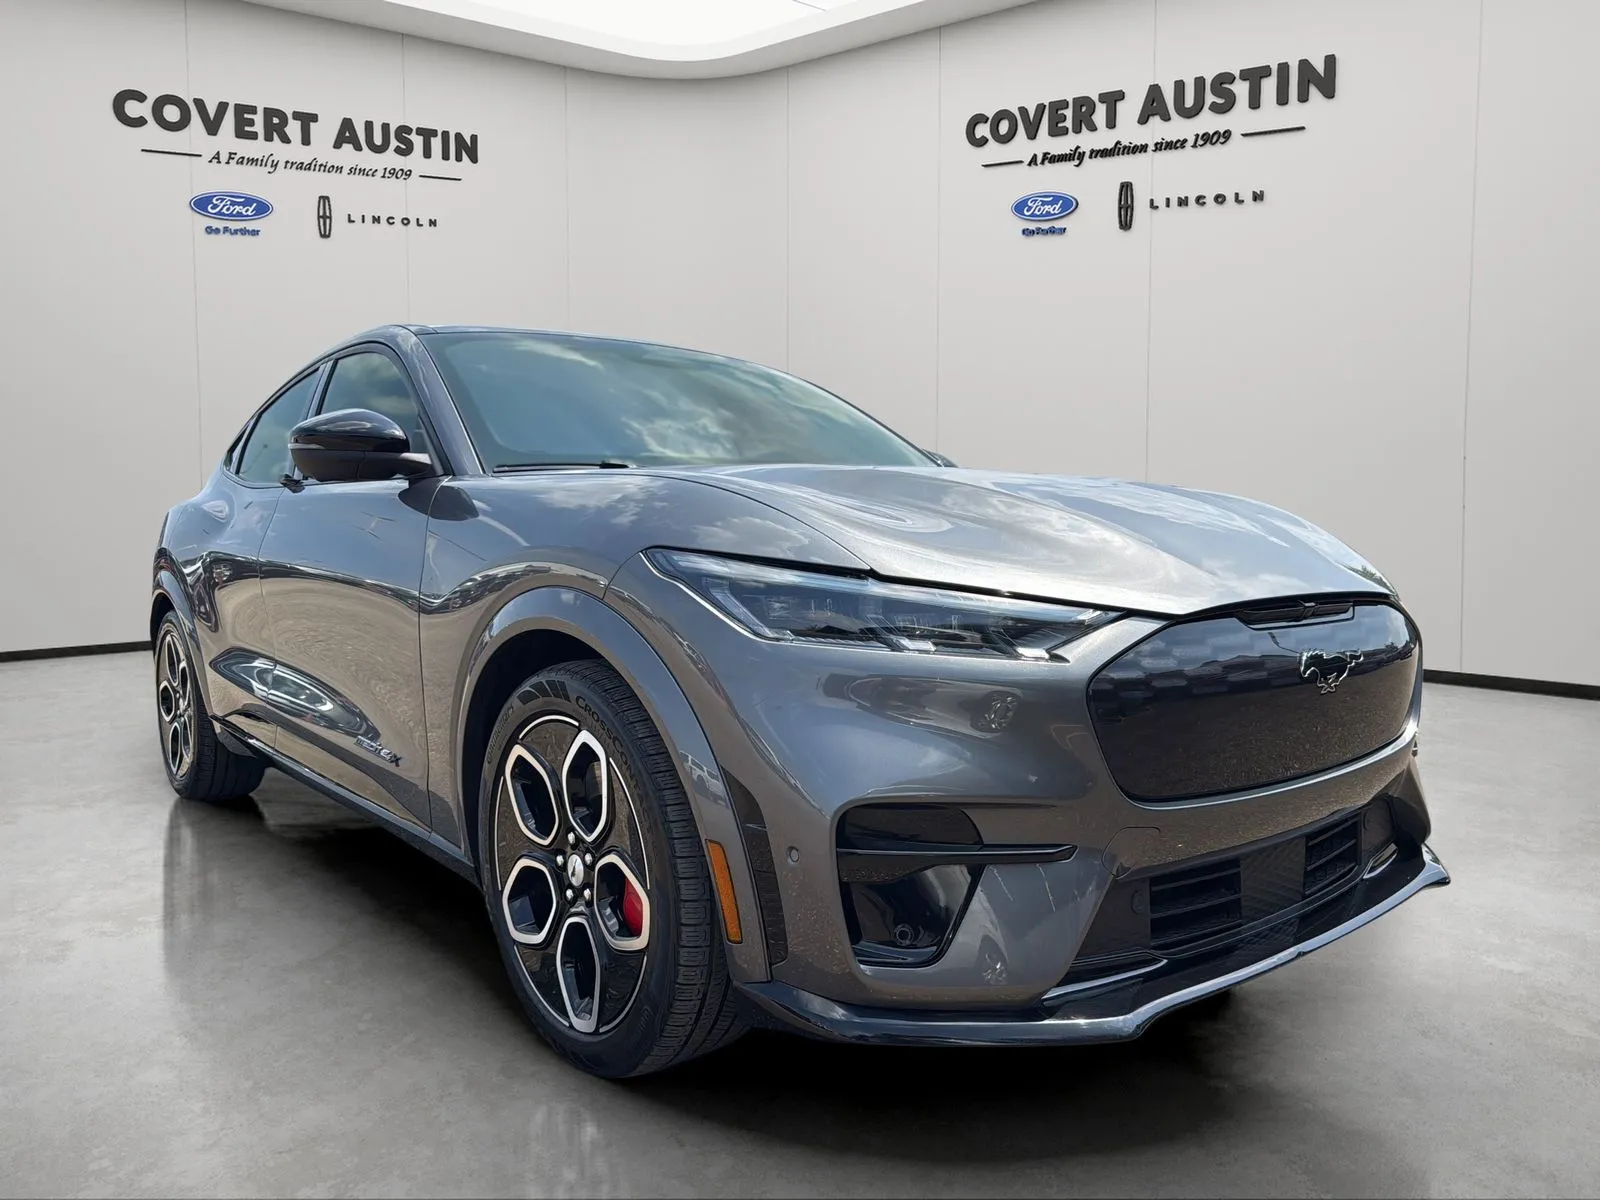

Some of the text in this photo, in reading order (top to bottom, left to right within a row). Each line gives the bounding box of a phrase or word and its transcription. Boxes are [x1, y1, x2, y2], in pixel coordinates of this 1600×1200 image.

[965, 53, 1337, 149] COVERT AUSTIN
[112, 88, 479, 165] COVERT AUSTIN
[1026, 128, 1232, 168] A Family tradition since 1909
[207, 150, 413, 181] A Family tradition since 1909
[1149, 189, 1265, 211] LINCOLN
[204, 225, 261, 237] Go Further
[347, 213, 437, 228] LINCOLN
